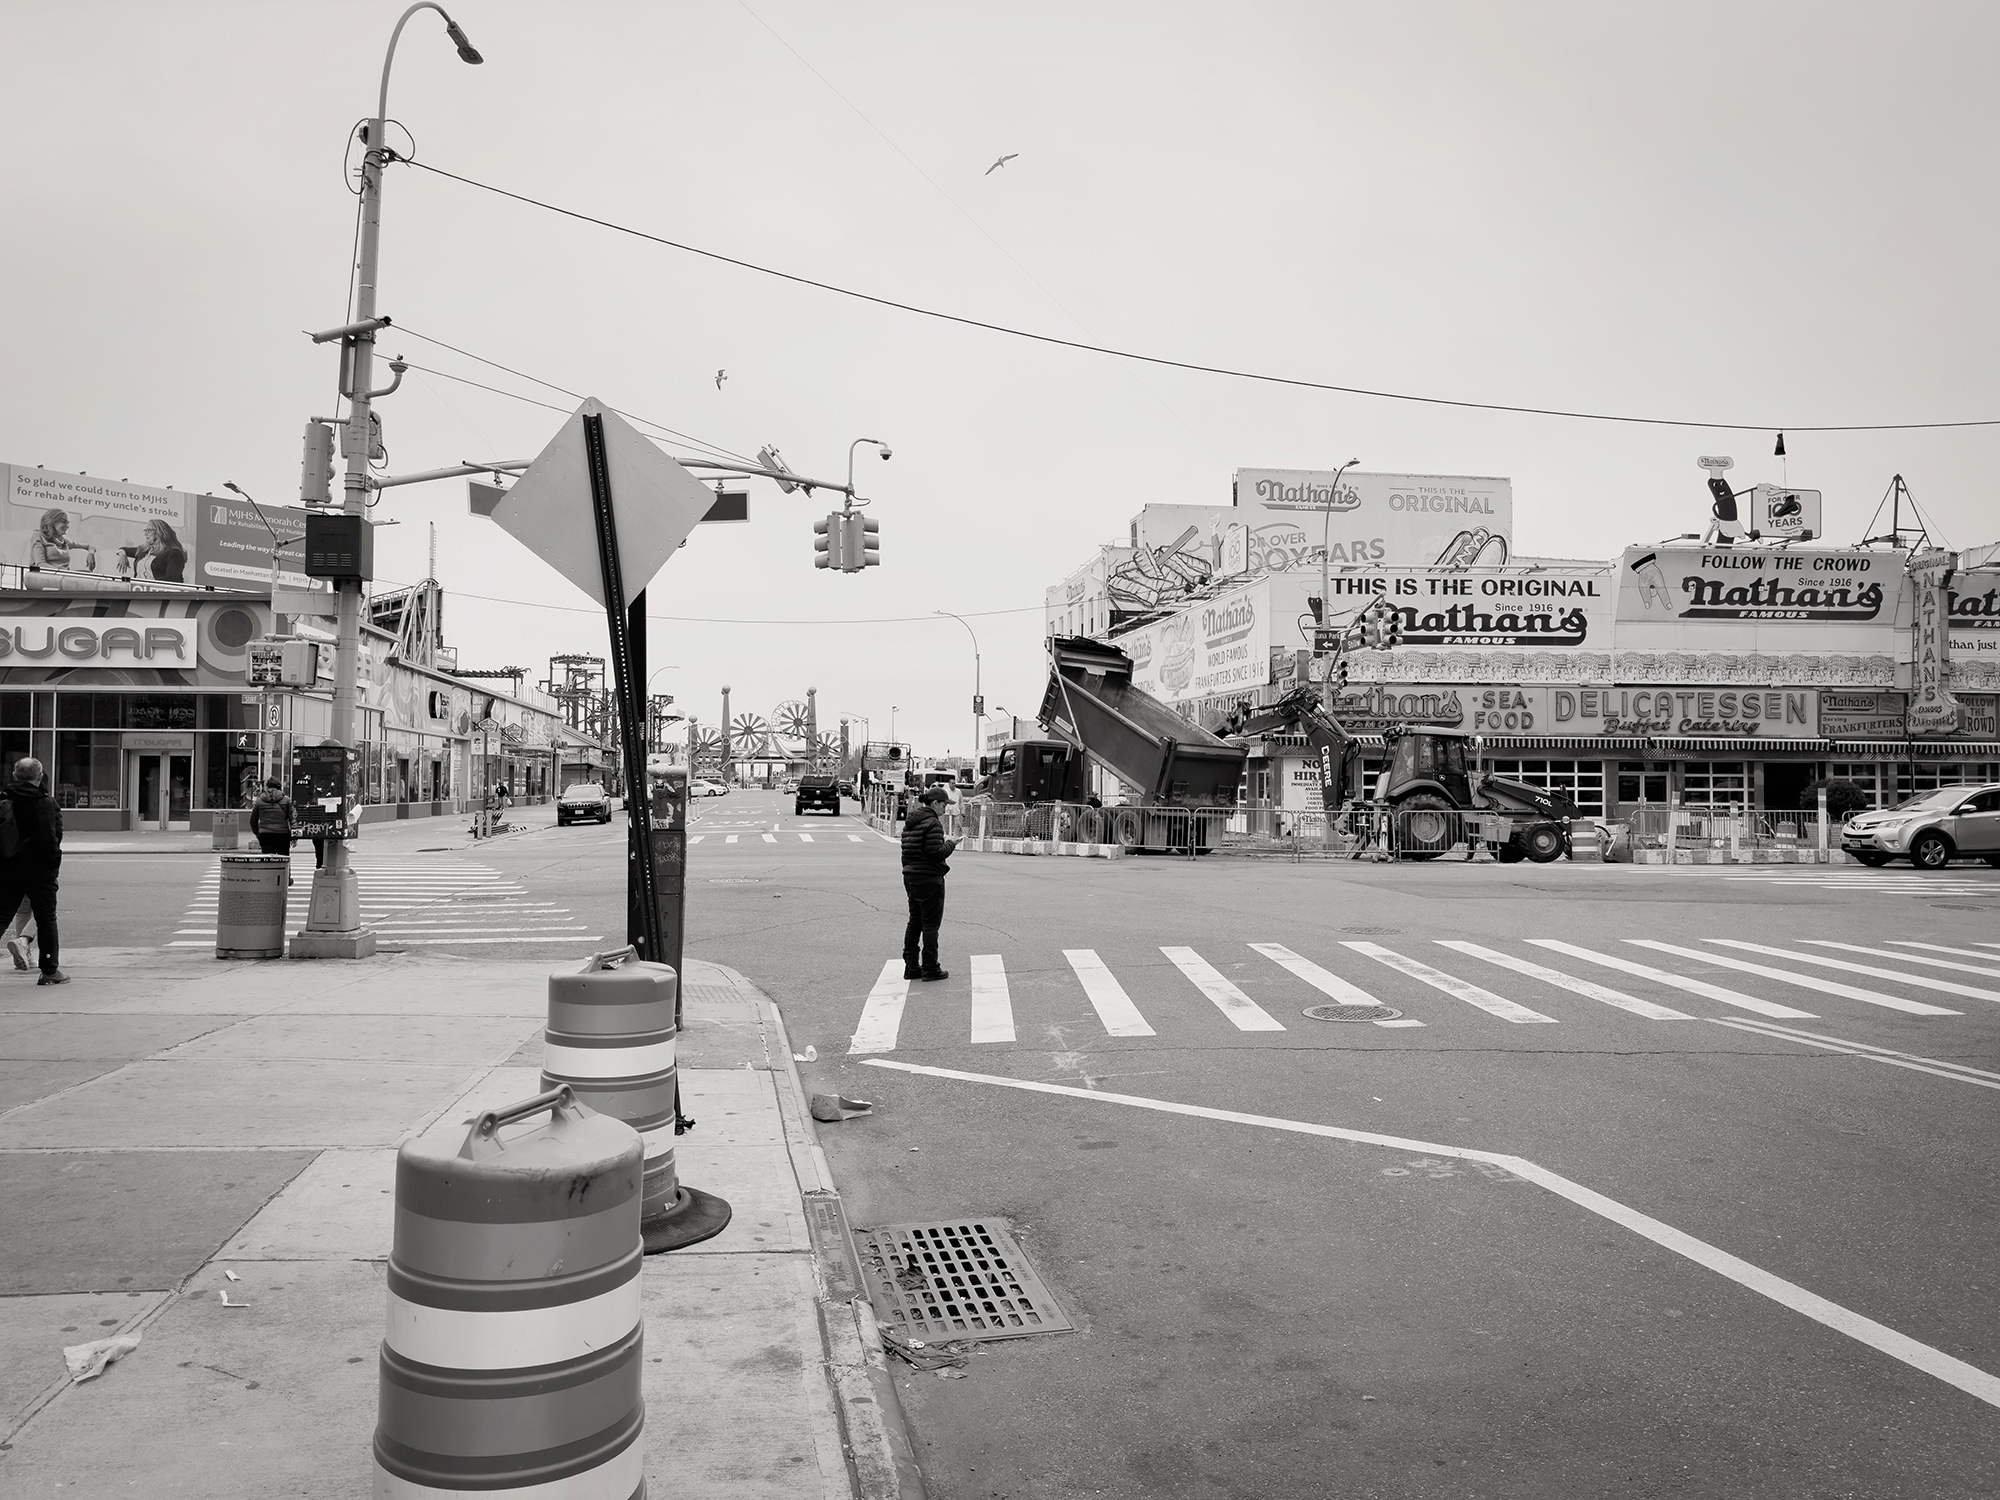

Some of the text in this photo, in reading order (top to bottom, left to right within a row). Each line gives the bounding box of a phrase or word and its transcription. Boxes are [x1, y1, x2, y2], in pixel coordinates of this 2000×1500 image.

[18, 475, 30, 483] So
[33, 477, 55, 488] glad
[75, 484, 103, 495] could
[105, 489, 127, 498] turn
[129, 492, 140, 500] to
[142, 494, 168, 504] MJHS
[1255, 479, 1360, 504] Nathan's
[17, 487, 179, 518] for rehab after my uncle's stroke
[1389, 494, 1494, 514] ORIGINAL
[229, 509, 254, 521] MJHS
[255, 514, 292, 527] Menorah
[1767, 517, 1803, 528] YEARS
[1270, 532, 1307, 546] OVER
[220, 540, 245, 551] Leading
[278, 550, 295, 558] great
[1296, 538, 1386, 564] YEARS
[210, 566, 232, 574] Located
[240, 570, 269, 578] Manhattan
[1701, 555, 1871, 572] FOLLOW THE CROWD
[1331, 578, 1601, 597] THIS IS THE ORIGINAL
[1682, 576, 1884, 607] Nathan's
[1798, 578, 1852, 587] Since 1916
[1202, 594, 1255, 637] Nathan's
[1495, 603, 1553, 612] Since 1916
[1739, 611, 1809, 619] FAMOUS
[1443, 637, 1517, 645] FAMOUS
[1922, 571, 1936, 701] NATHANS
[1949, 640, 1998, 651] than just
[1208, 644, 1248, 667] WORLD FAMOUS
[1195, 661, 1264, 690] FRANKFURTERS SINCE 1916
[1304, 686, 1463, 718] athan's
[1483, 690, 1528, 709] SEA
[1555, 691, 1807, 723] DELICATESSEN
[1822, 695, 1875, 708] Nathan's
[1474, 711, 1534, 730] FOOD
[1970, 708, 1986, 717] THE
[1603, 717, 1761, 735] Buffet Catering
[1822, 717, 1904, 734] FRANKFURTERS
[1967, 716, 1995, 734] ROWD
[1302, 760, 1320, 769] NO
[1321, 745, 1333, 788] DEERE
[1293, 772, 1321, 781] HIR
[1535, 795, 1553, 807] 710L
